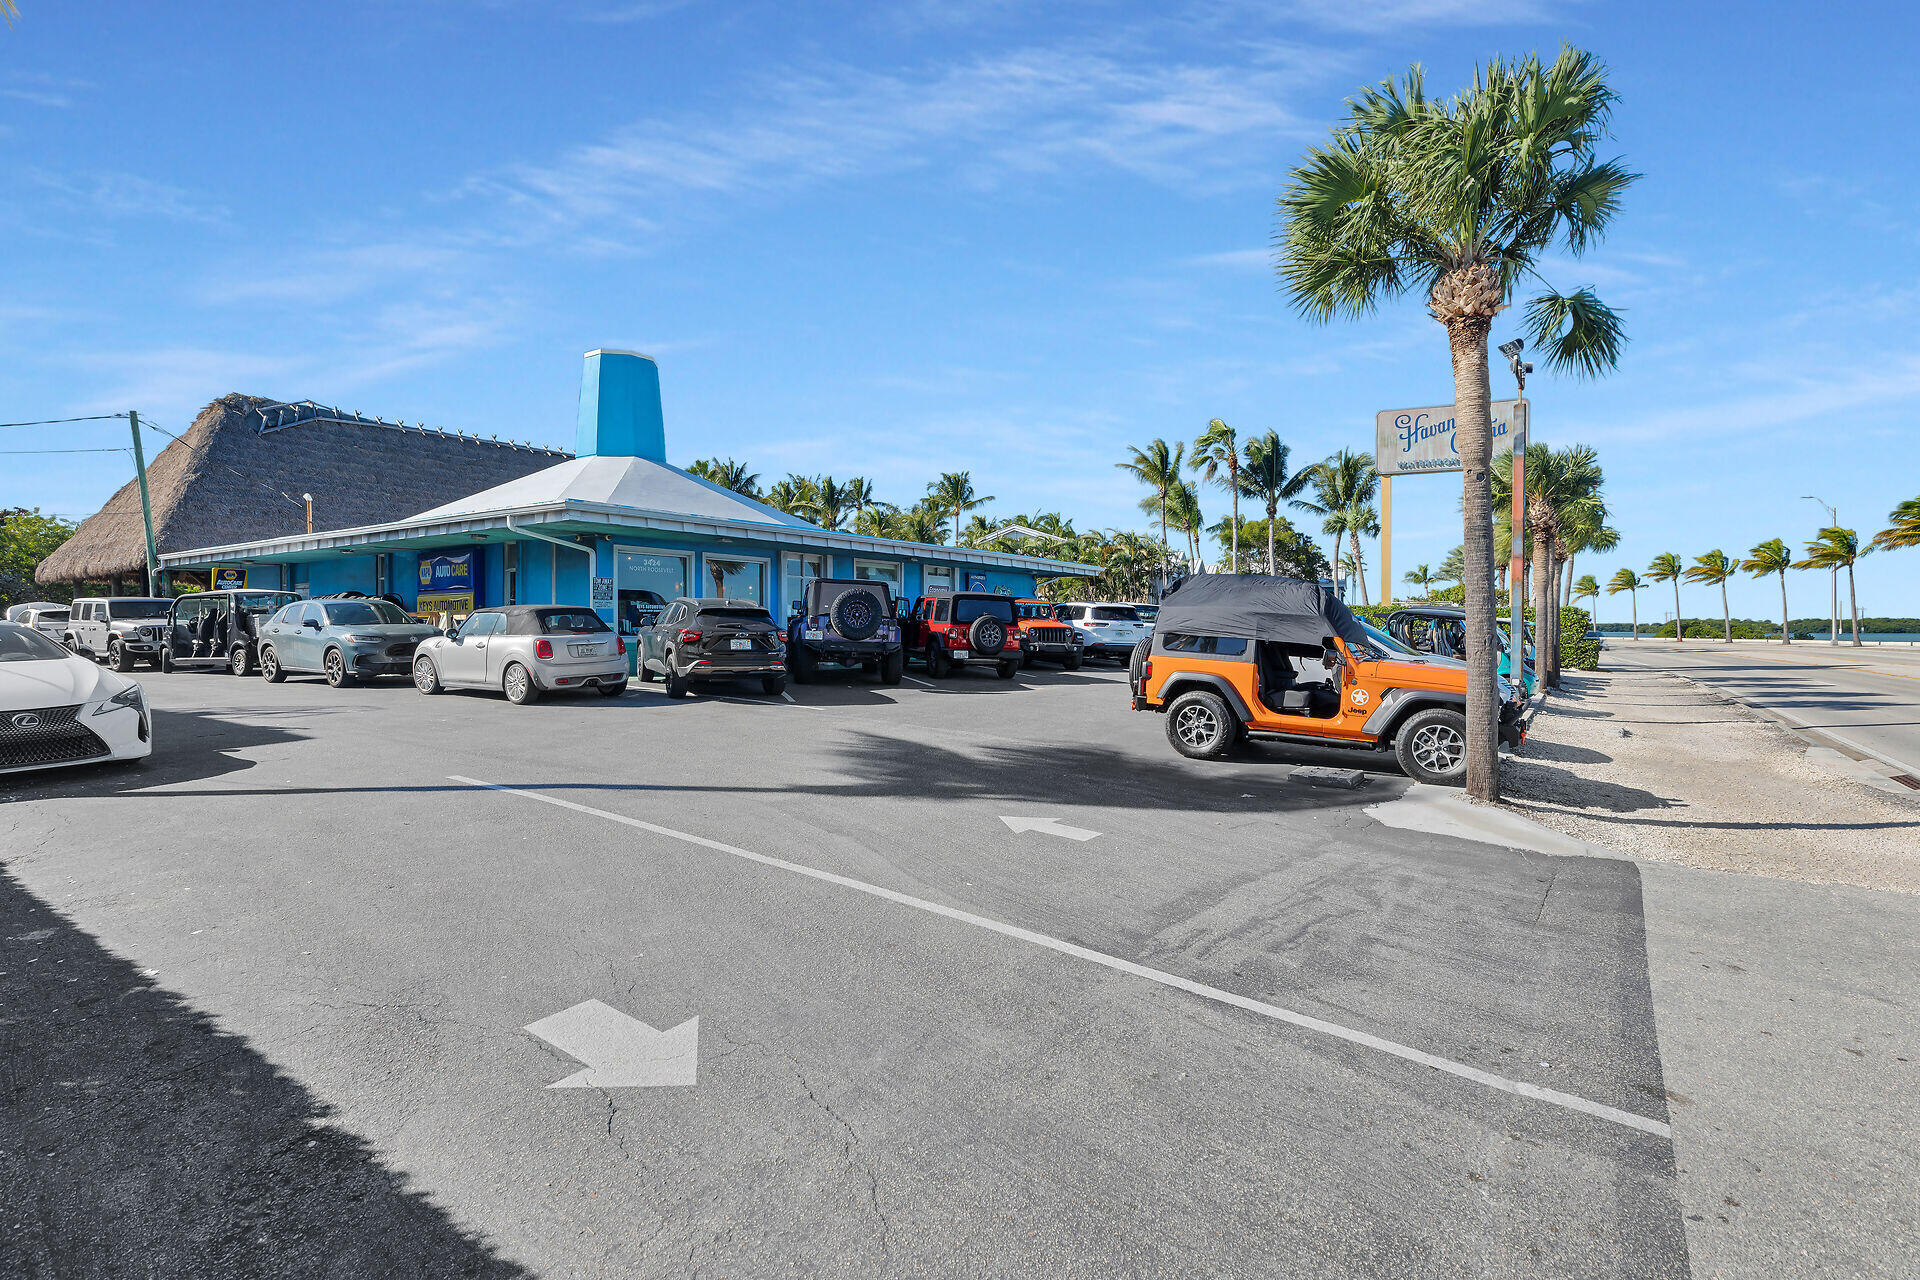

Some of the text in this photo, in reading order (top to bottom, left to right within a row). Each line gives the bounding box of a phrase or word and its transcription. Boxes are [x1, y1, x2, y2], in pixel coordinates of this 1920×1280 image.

[1394, 413, 1457, 452] Havan
[1397, 457, 1461, 470] WATERFRON
[435, 563, 468, 578] AUTO CARE
[419, 599, 469, 611] KEYS AUTOMOTIVE
[1348, 707, 1367, 715] Jeep
